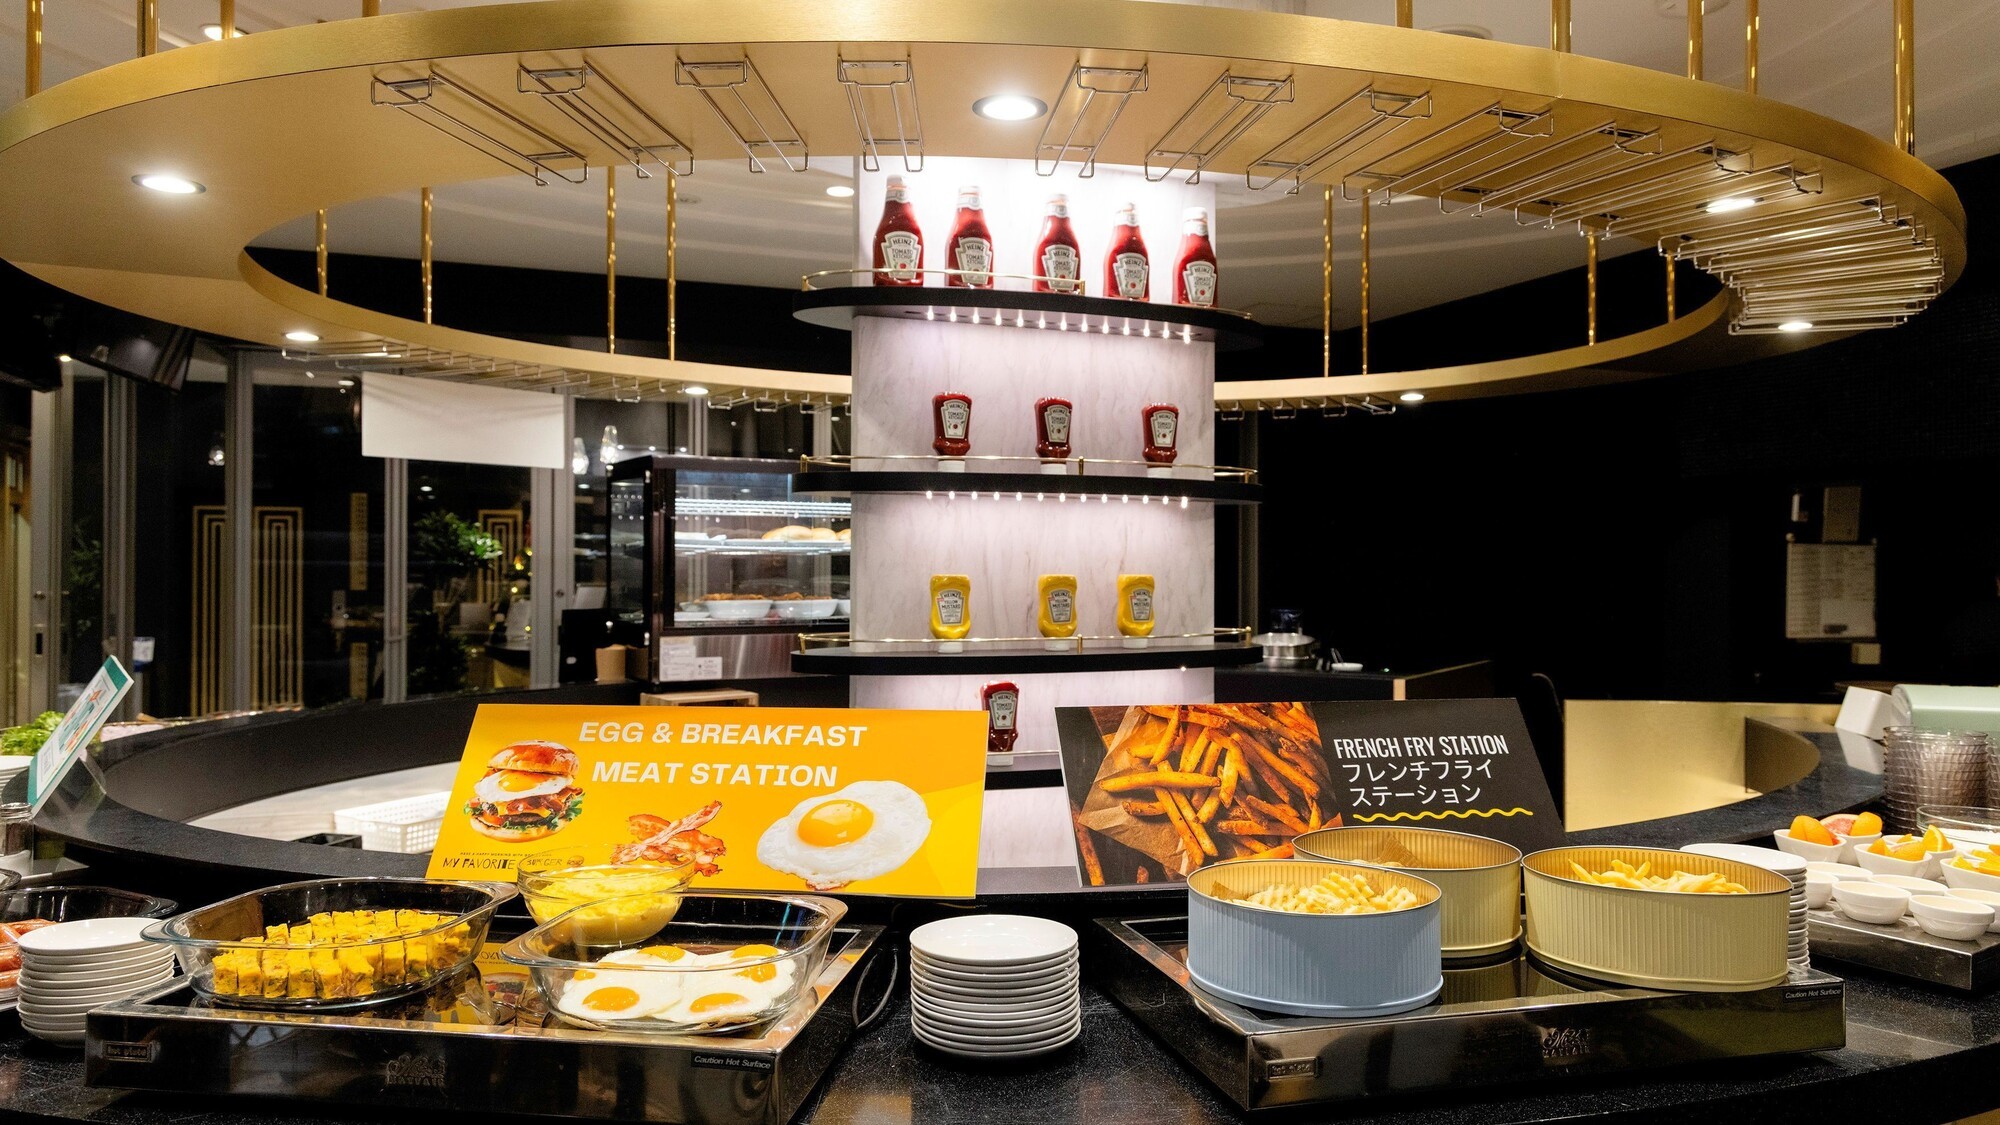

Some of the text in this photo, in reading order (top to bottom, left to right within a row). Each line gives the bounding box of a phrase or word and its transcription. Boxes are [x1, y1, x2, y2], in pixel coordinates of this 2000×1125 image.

[1053, 250, 1070, 258] HEINZ
[578, 721, 868, 747] EGG & BREAKFAST
[1333, 734, 1510, 759] FRENCH FRY STATION
[591, 761, 838, 787] MEAT STATION
[1342, 758, 1492, 783] フレンチフライ
[1349, 784, 1481, 807] ステーション
[442, 857, 461, 868] MY
[462, 858, 516, 870] FAVORITE
[1785, 988, 1842, 999] Caution Hot Surface
[694, 1055, 771, 1069] Caution Hot Surface
